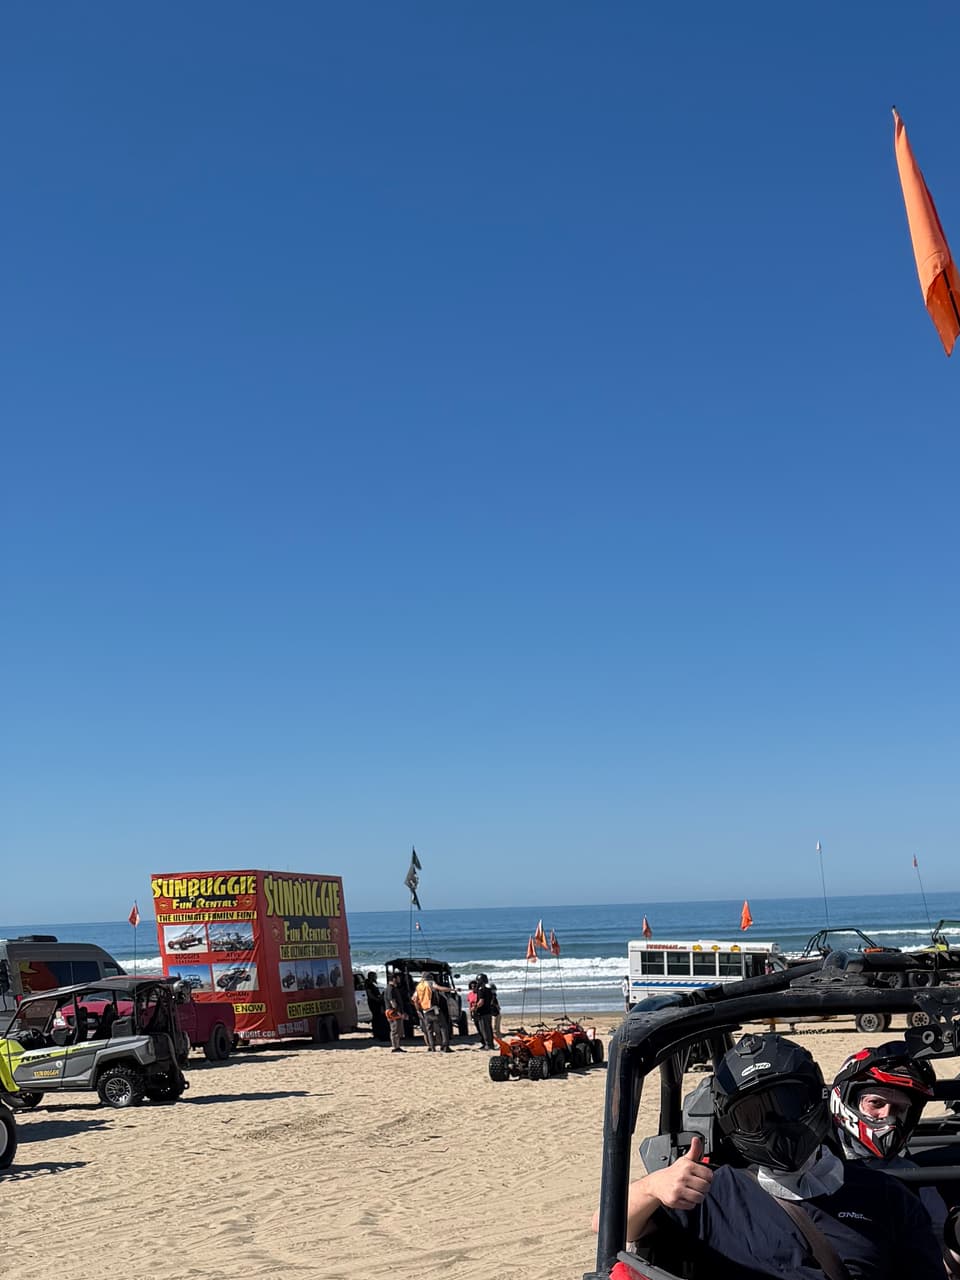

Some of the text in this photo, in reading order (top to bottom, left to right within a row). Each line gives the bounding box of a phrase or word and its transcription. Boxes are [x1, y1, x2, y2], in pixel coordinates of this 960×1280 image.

[151, 875, 257, 898] SUNBUGGIE
[264, 875, 341, 917] SUNBUGGIE
[159, 914, 173, 923] THE
[174, 913, 208, 922] ULTIMATE
[208, 911, 234, 921] FAMILY
[241, 1004, 264, 1012] NOW
